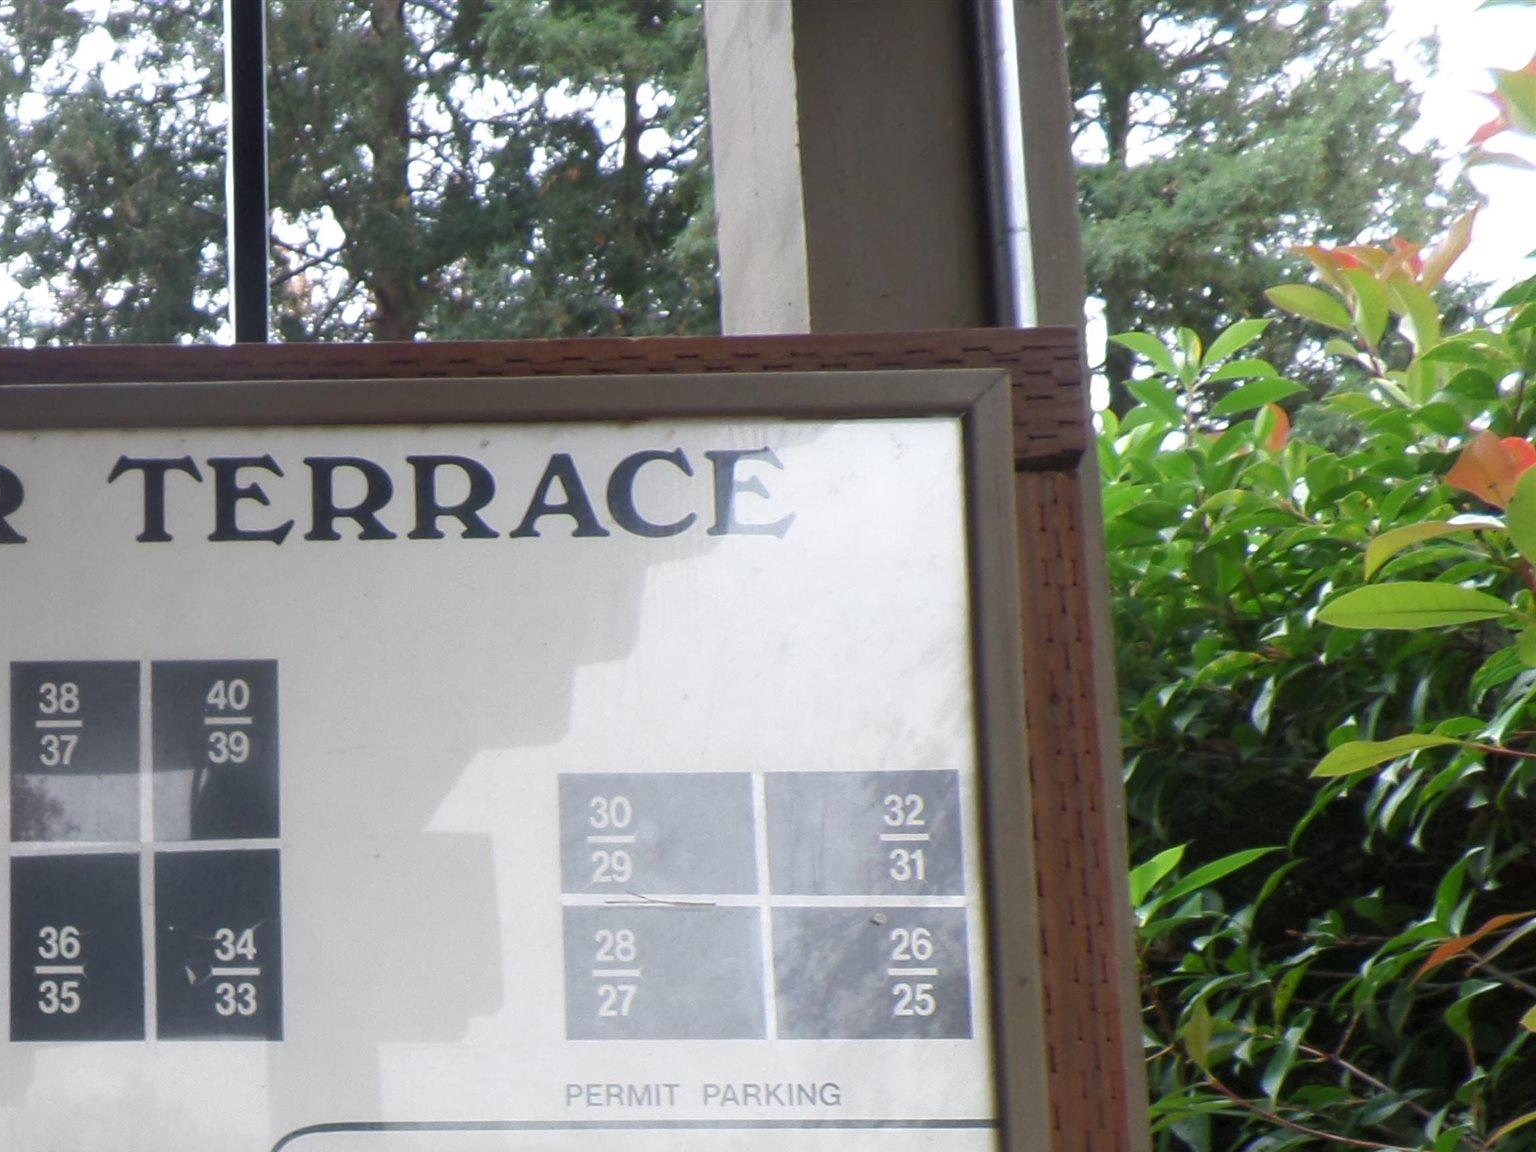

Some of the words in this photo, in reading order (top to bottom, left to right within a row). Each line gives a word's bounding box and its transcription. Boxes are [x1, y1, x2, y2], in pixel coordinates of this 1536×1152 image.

[109, 445, 798, 545] TERRACE
[37, 682, 81, 715] 38
[206, 680, 251, 712] 40
[39, 734, 80, 767] 37
[208, 732, 251, 764] 39
[588, 796, 633, 830] 30
[883, 794, 925, 828] 32
[590, 850, 634, 883] 29
[888, 848, 926, 881] 31
[37, 927, 81, 961] 36
[213, 929, 257, 962] 34
[594, 929, 636, 963] 28
[889, 928, 933, 962] 26
[37, 981, 81, 1015] 35
[215, 982, 258, 1017] 33
[597, 985, 638, 1018] 27
[892, 983, 936, 1017] 25
[565, 1082, 681, 1109] PERMIT
[702, 1082, 841, 1109] PARKING
